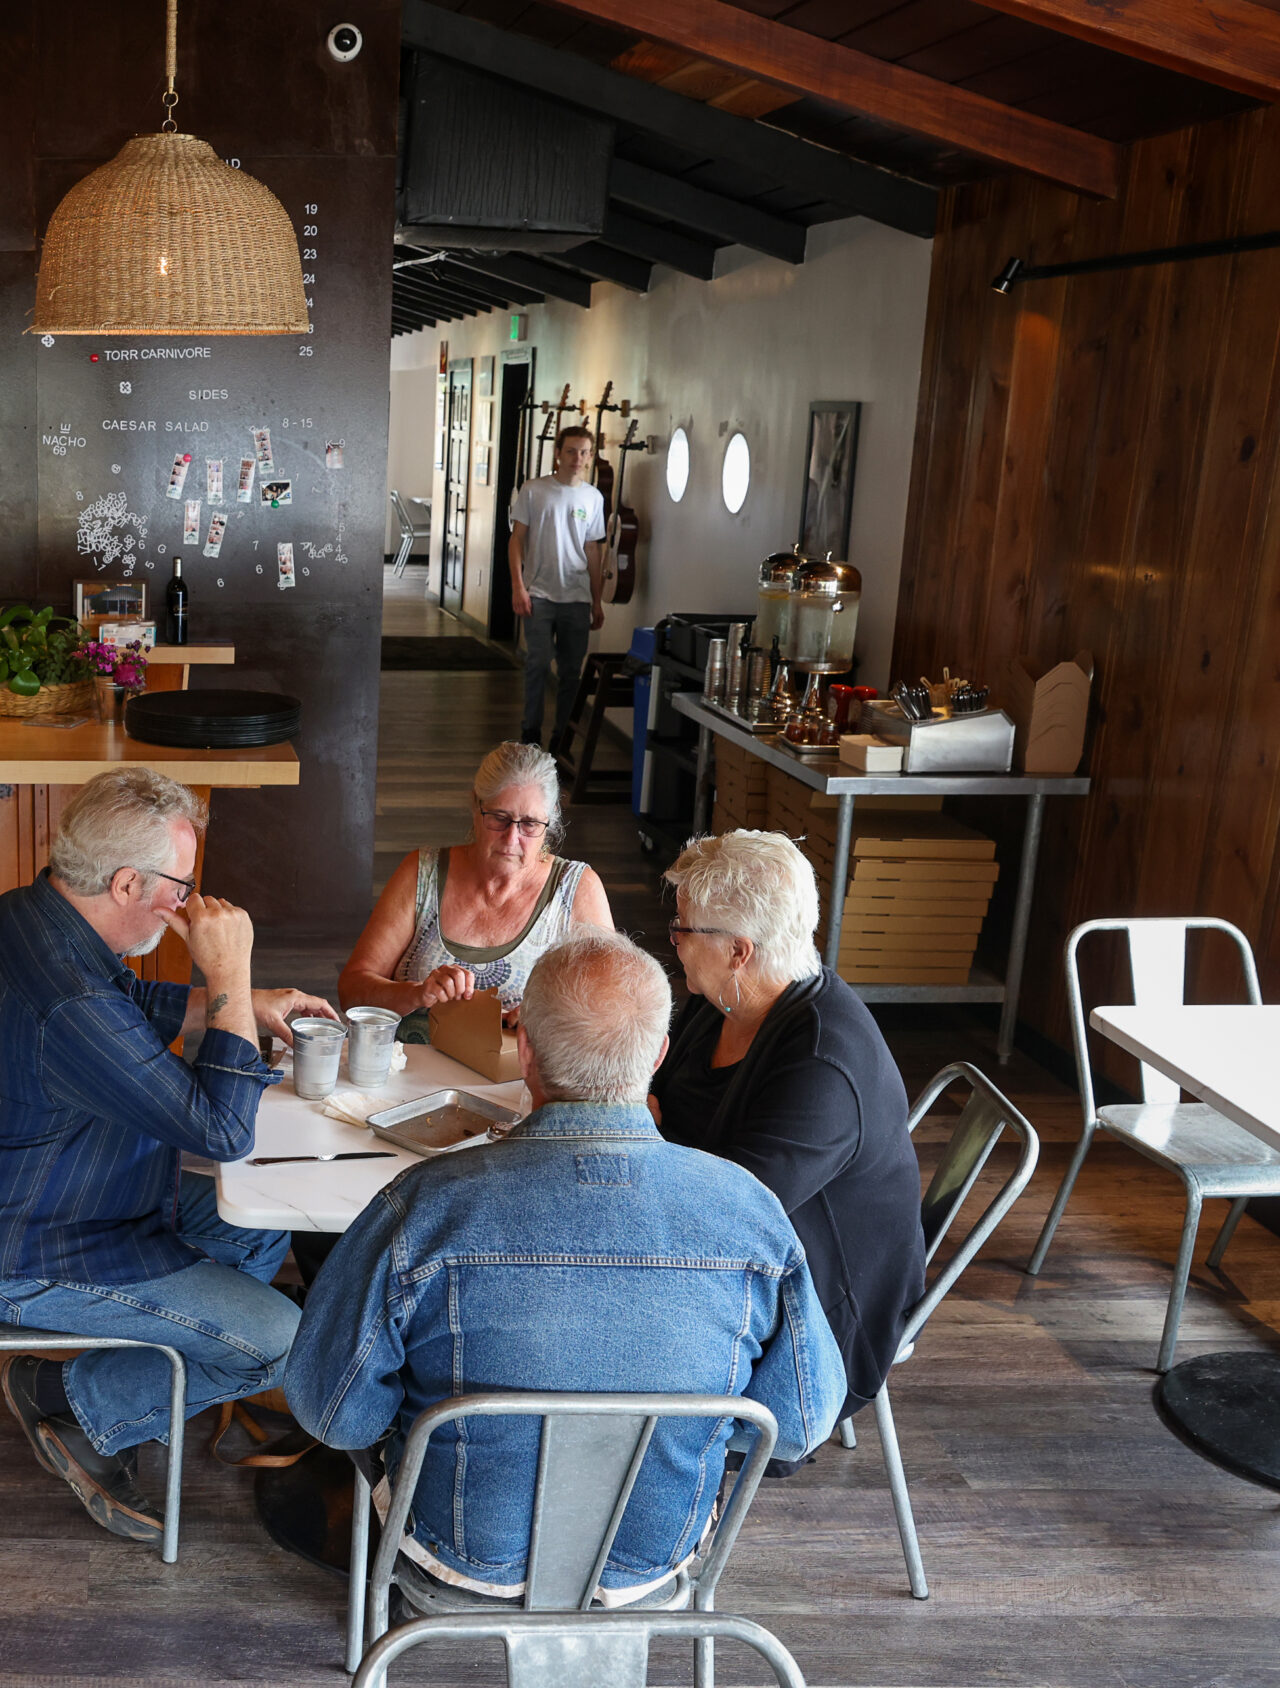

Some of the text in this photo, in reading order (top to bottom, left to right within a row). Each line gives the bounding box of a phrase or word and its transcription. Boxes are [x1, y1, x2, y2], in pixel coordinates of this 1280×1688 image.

[304, 204, 318, 215] 19
[303, 225, 318, 236] 20
[303, 249, 318, 260] 23
[303, 274, 316, 284] 24
[104, 347, 212, 361] TORR CARNIVORE
[299, 346, 313, 357] 25
[188, 389, 229, 400] SIDES
[102, 420, 209, 432] CAESAR SALAD
[42, 435, 87, 448] NACHO
[52, 445, 67, 456] 69
